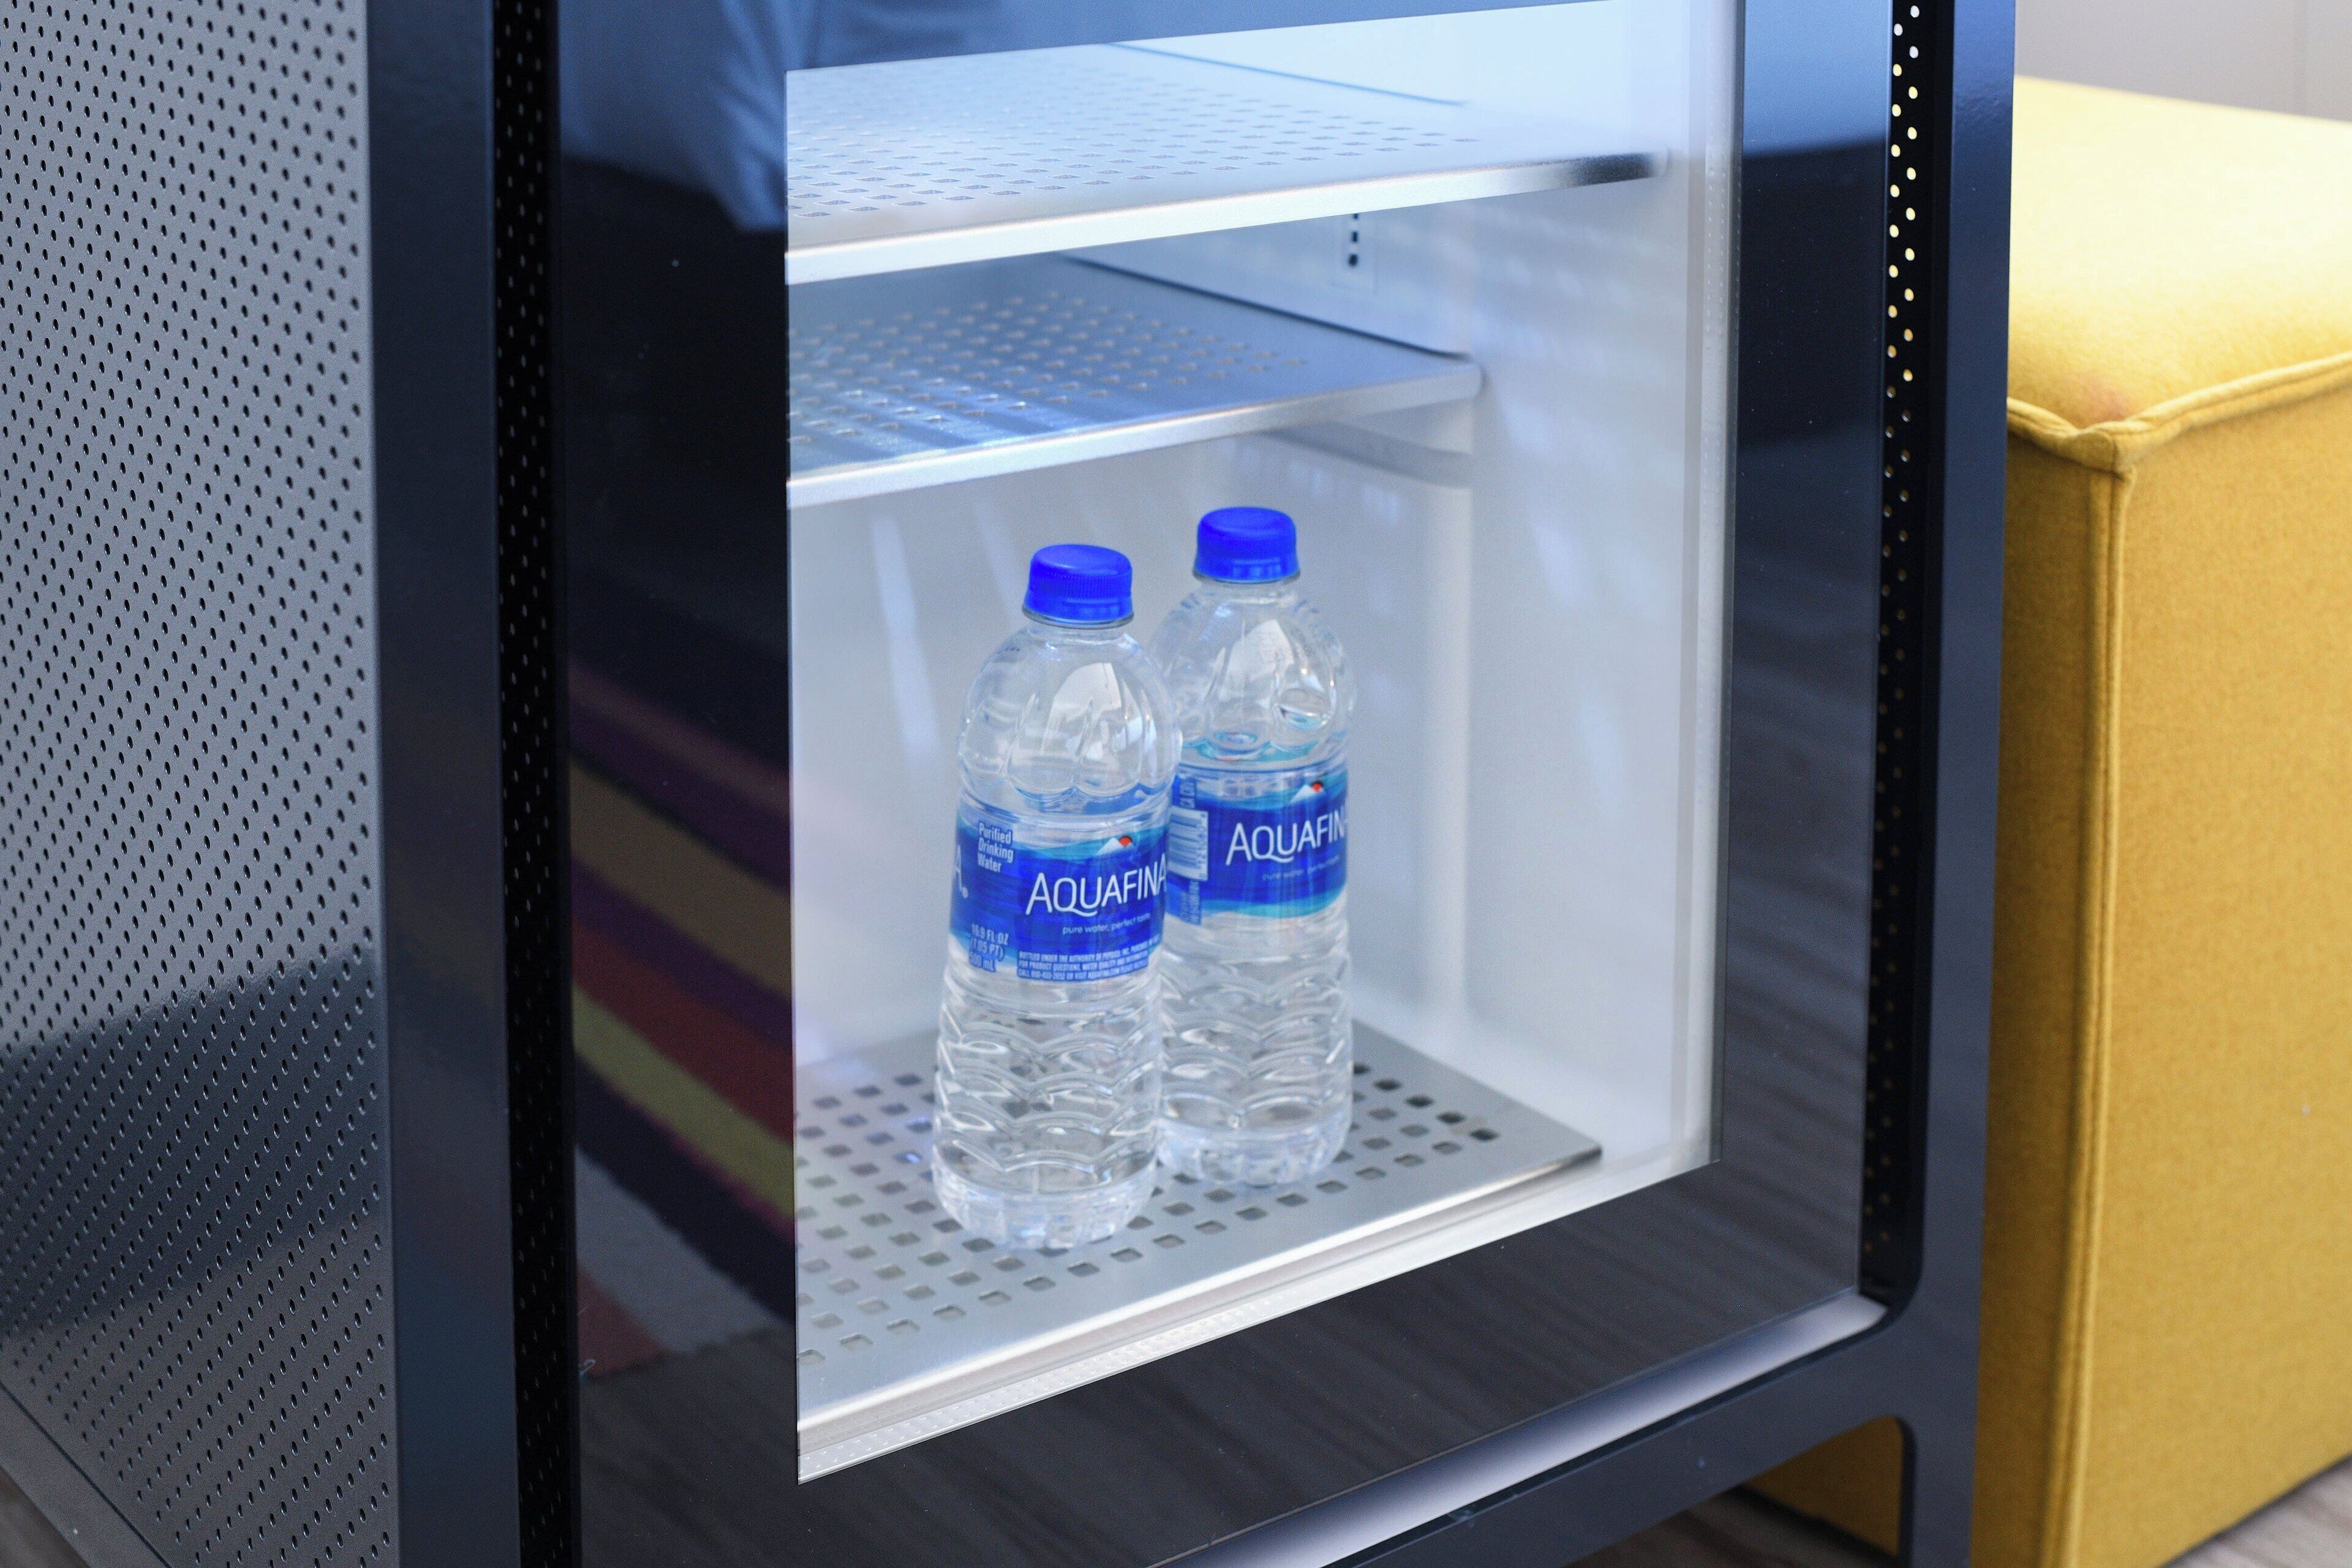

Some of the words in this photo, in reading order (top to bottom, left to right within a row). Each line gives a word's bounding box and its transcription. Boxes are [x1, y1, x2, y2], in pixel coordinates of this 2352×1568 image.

[979, 821, 1012, 845] Purified
[977, 851, 1002, 873] Water
[978, 837, 1014, 864] Drinking
[1025, 852, 1166, 917] AQUAFINA
[998, 932, 1009, 946] OZ
[1062, 925, 1083, 935] pure
